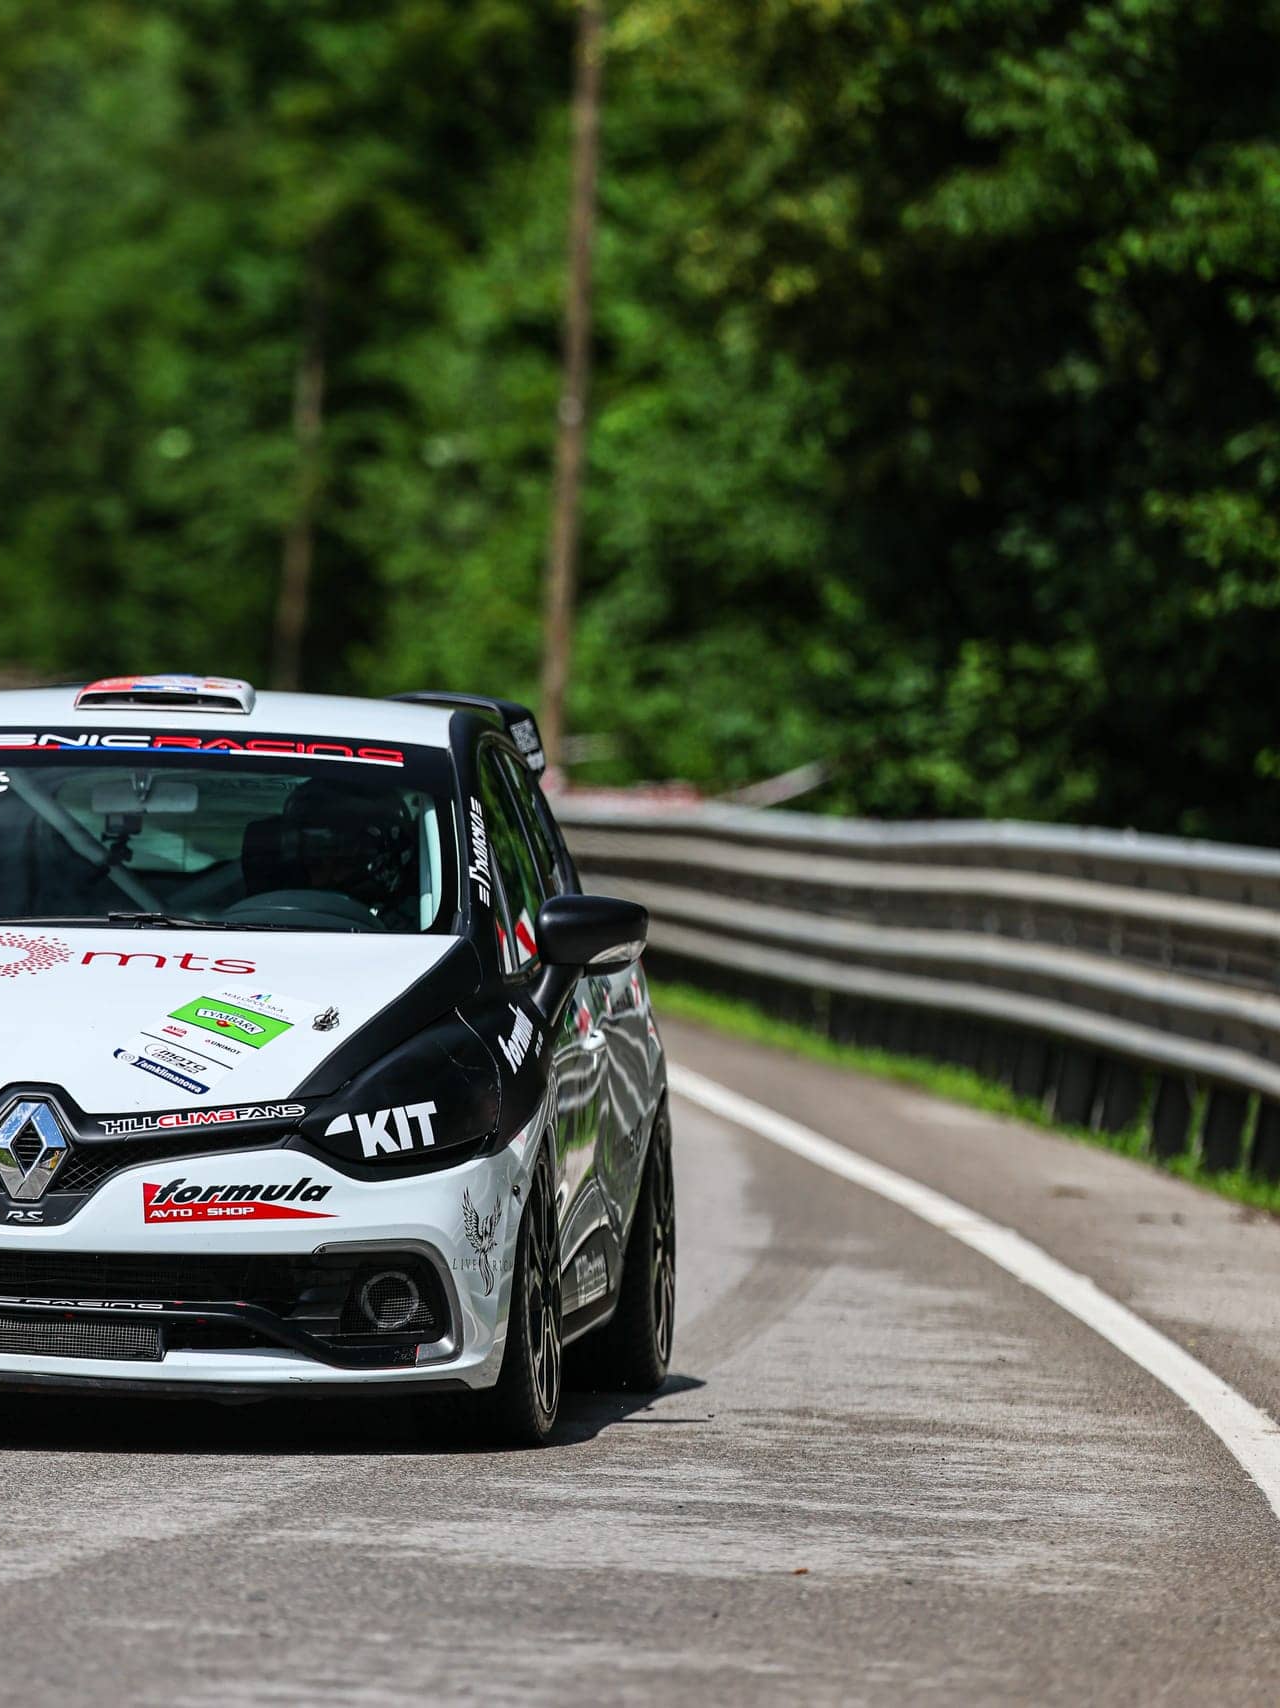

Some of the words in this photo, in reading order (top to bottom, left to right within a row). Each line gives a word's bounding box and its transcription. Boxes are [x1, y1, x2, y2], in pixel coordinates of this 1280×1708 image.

[81, 951, 257, 974] mts
[153, 1177, 333, 1203] formula
[6, 1210, 43, 1223] RS
[149, 1208, 193, 1218] AVTO
[207, 1207, 255, 1216] SHOP
